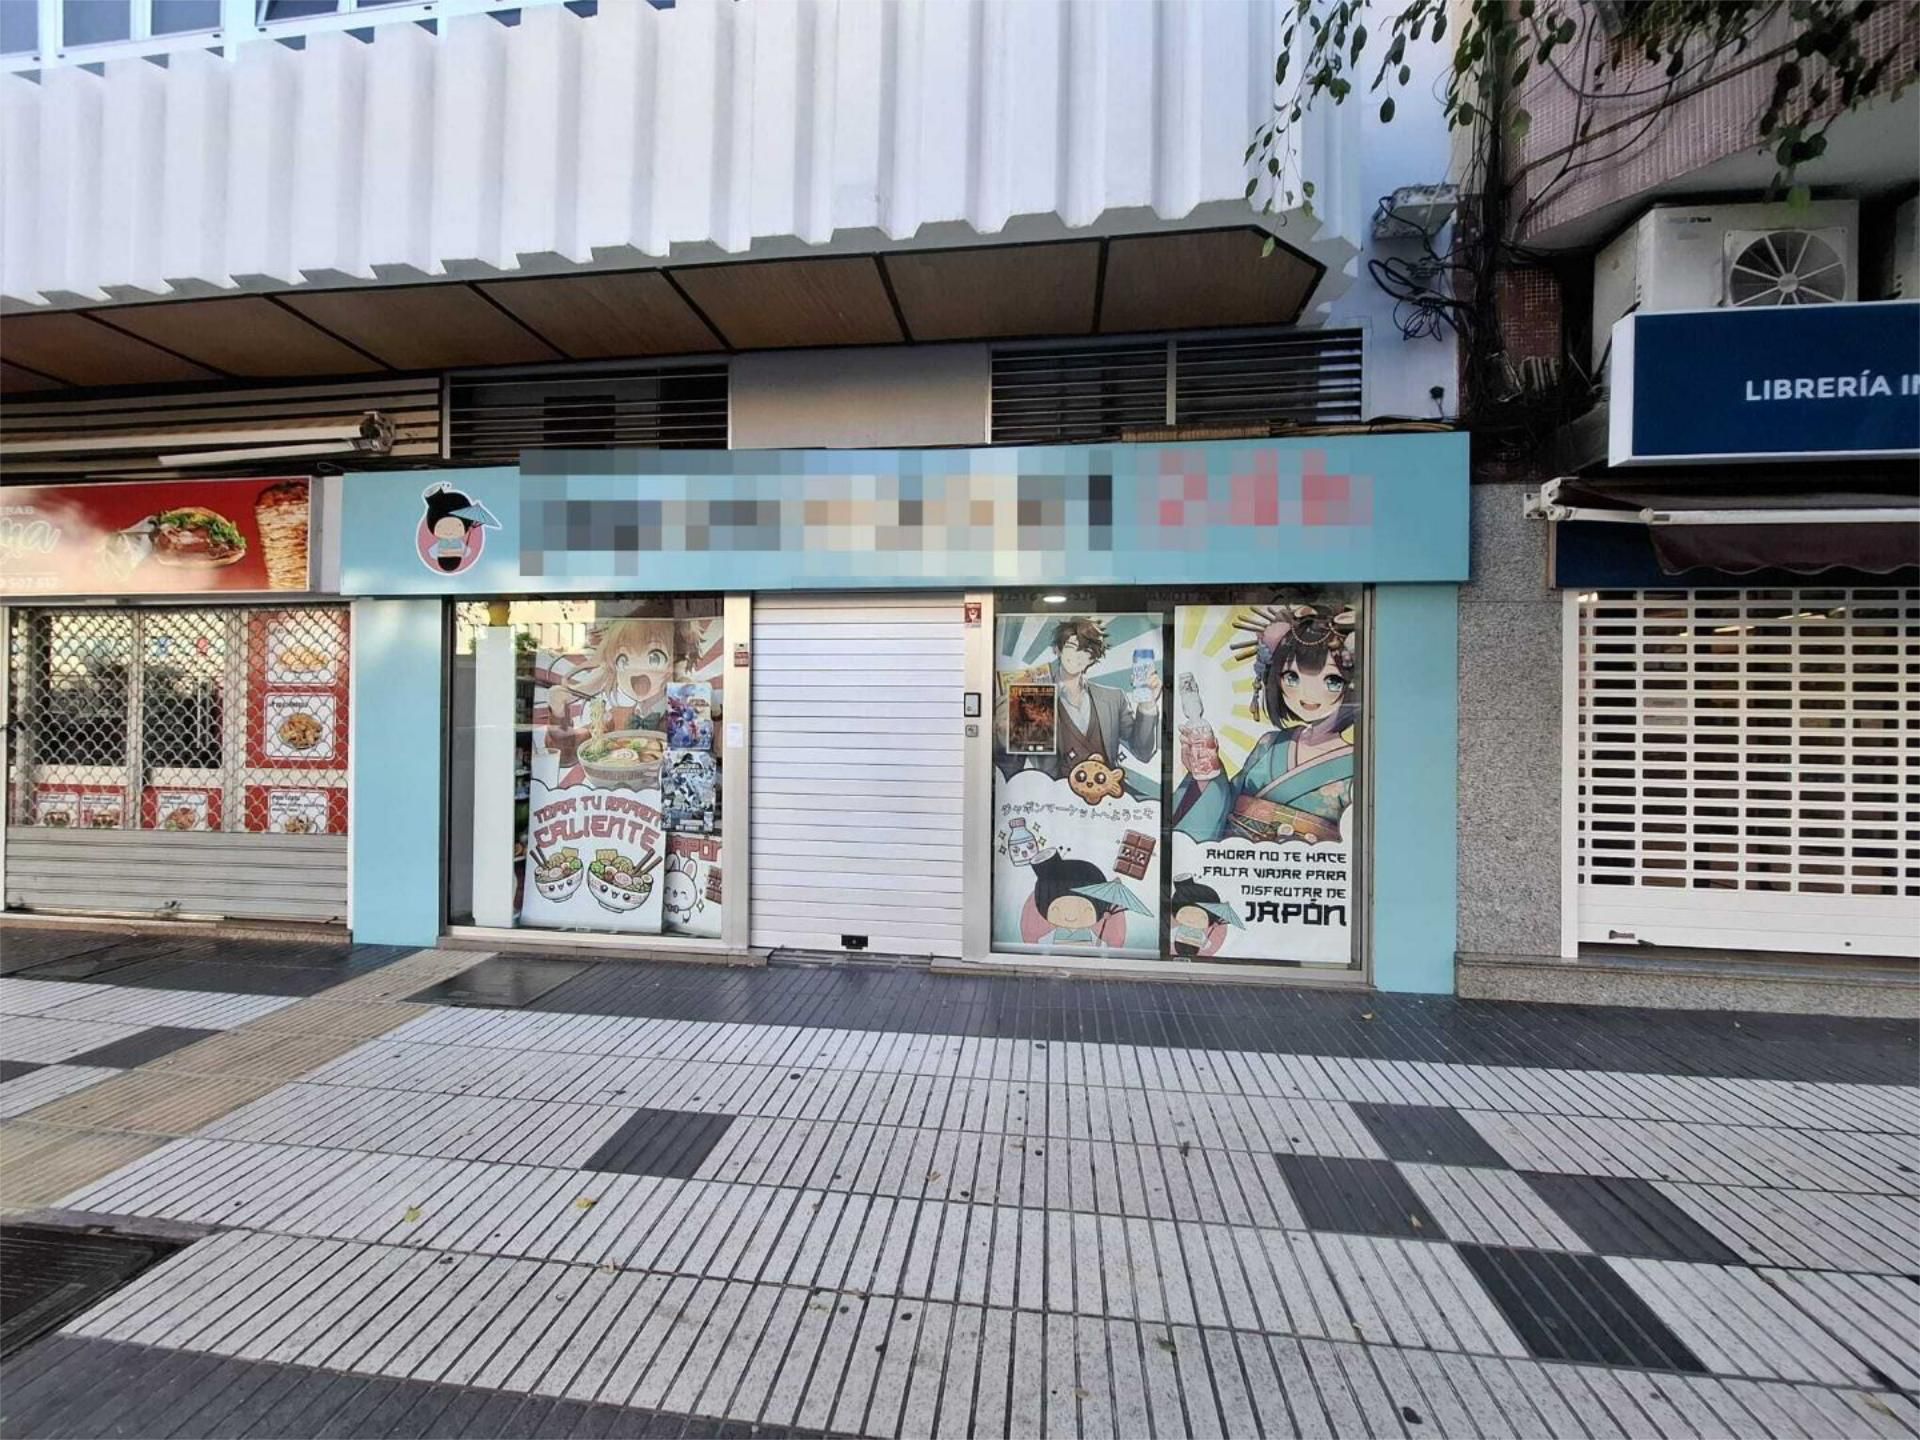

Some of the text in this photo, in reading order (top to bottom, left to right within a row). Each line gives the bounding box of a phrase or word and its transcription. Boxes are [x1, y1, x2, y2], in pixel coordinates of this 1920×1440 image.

[1746, 369, 1892, 401] LIBRERÍA
[533, 797, 577, 824] TOMA
[580, 795, 602, 811] TU
[533, 815, 660, 850] CALIENTE
[1205, 848, 1346, 864] AHORA NO TE HACE
[1202, 866, 1346, 881] FALTA VIAJAR PARA
[1241, 884, 1346, 899] DISFRUTAR DE
[1244, 898, 1347, 927] JAPÓN
